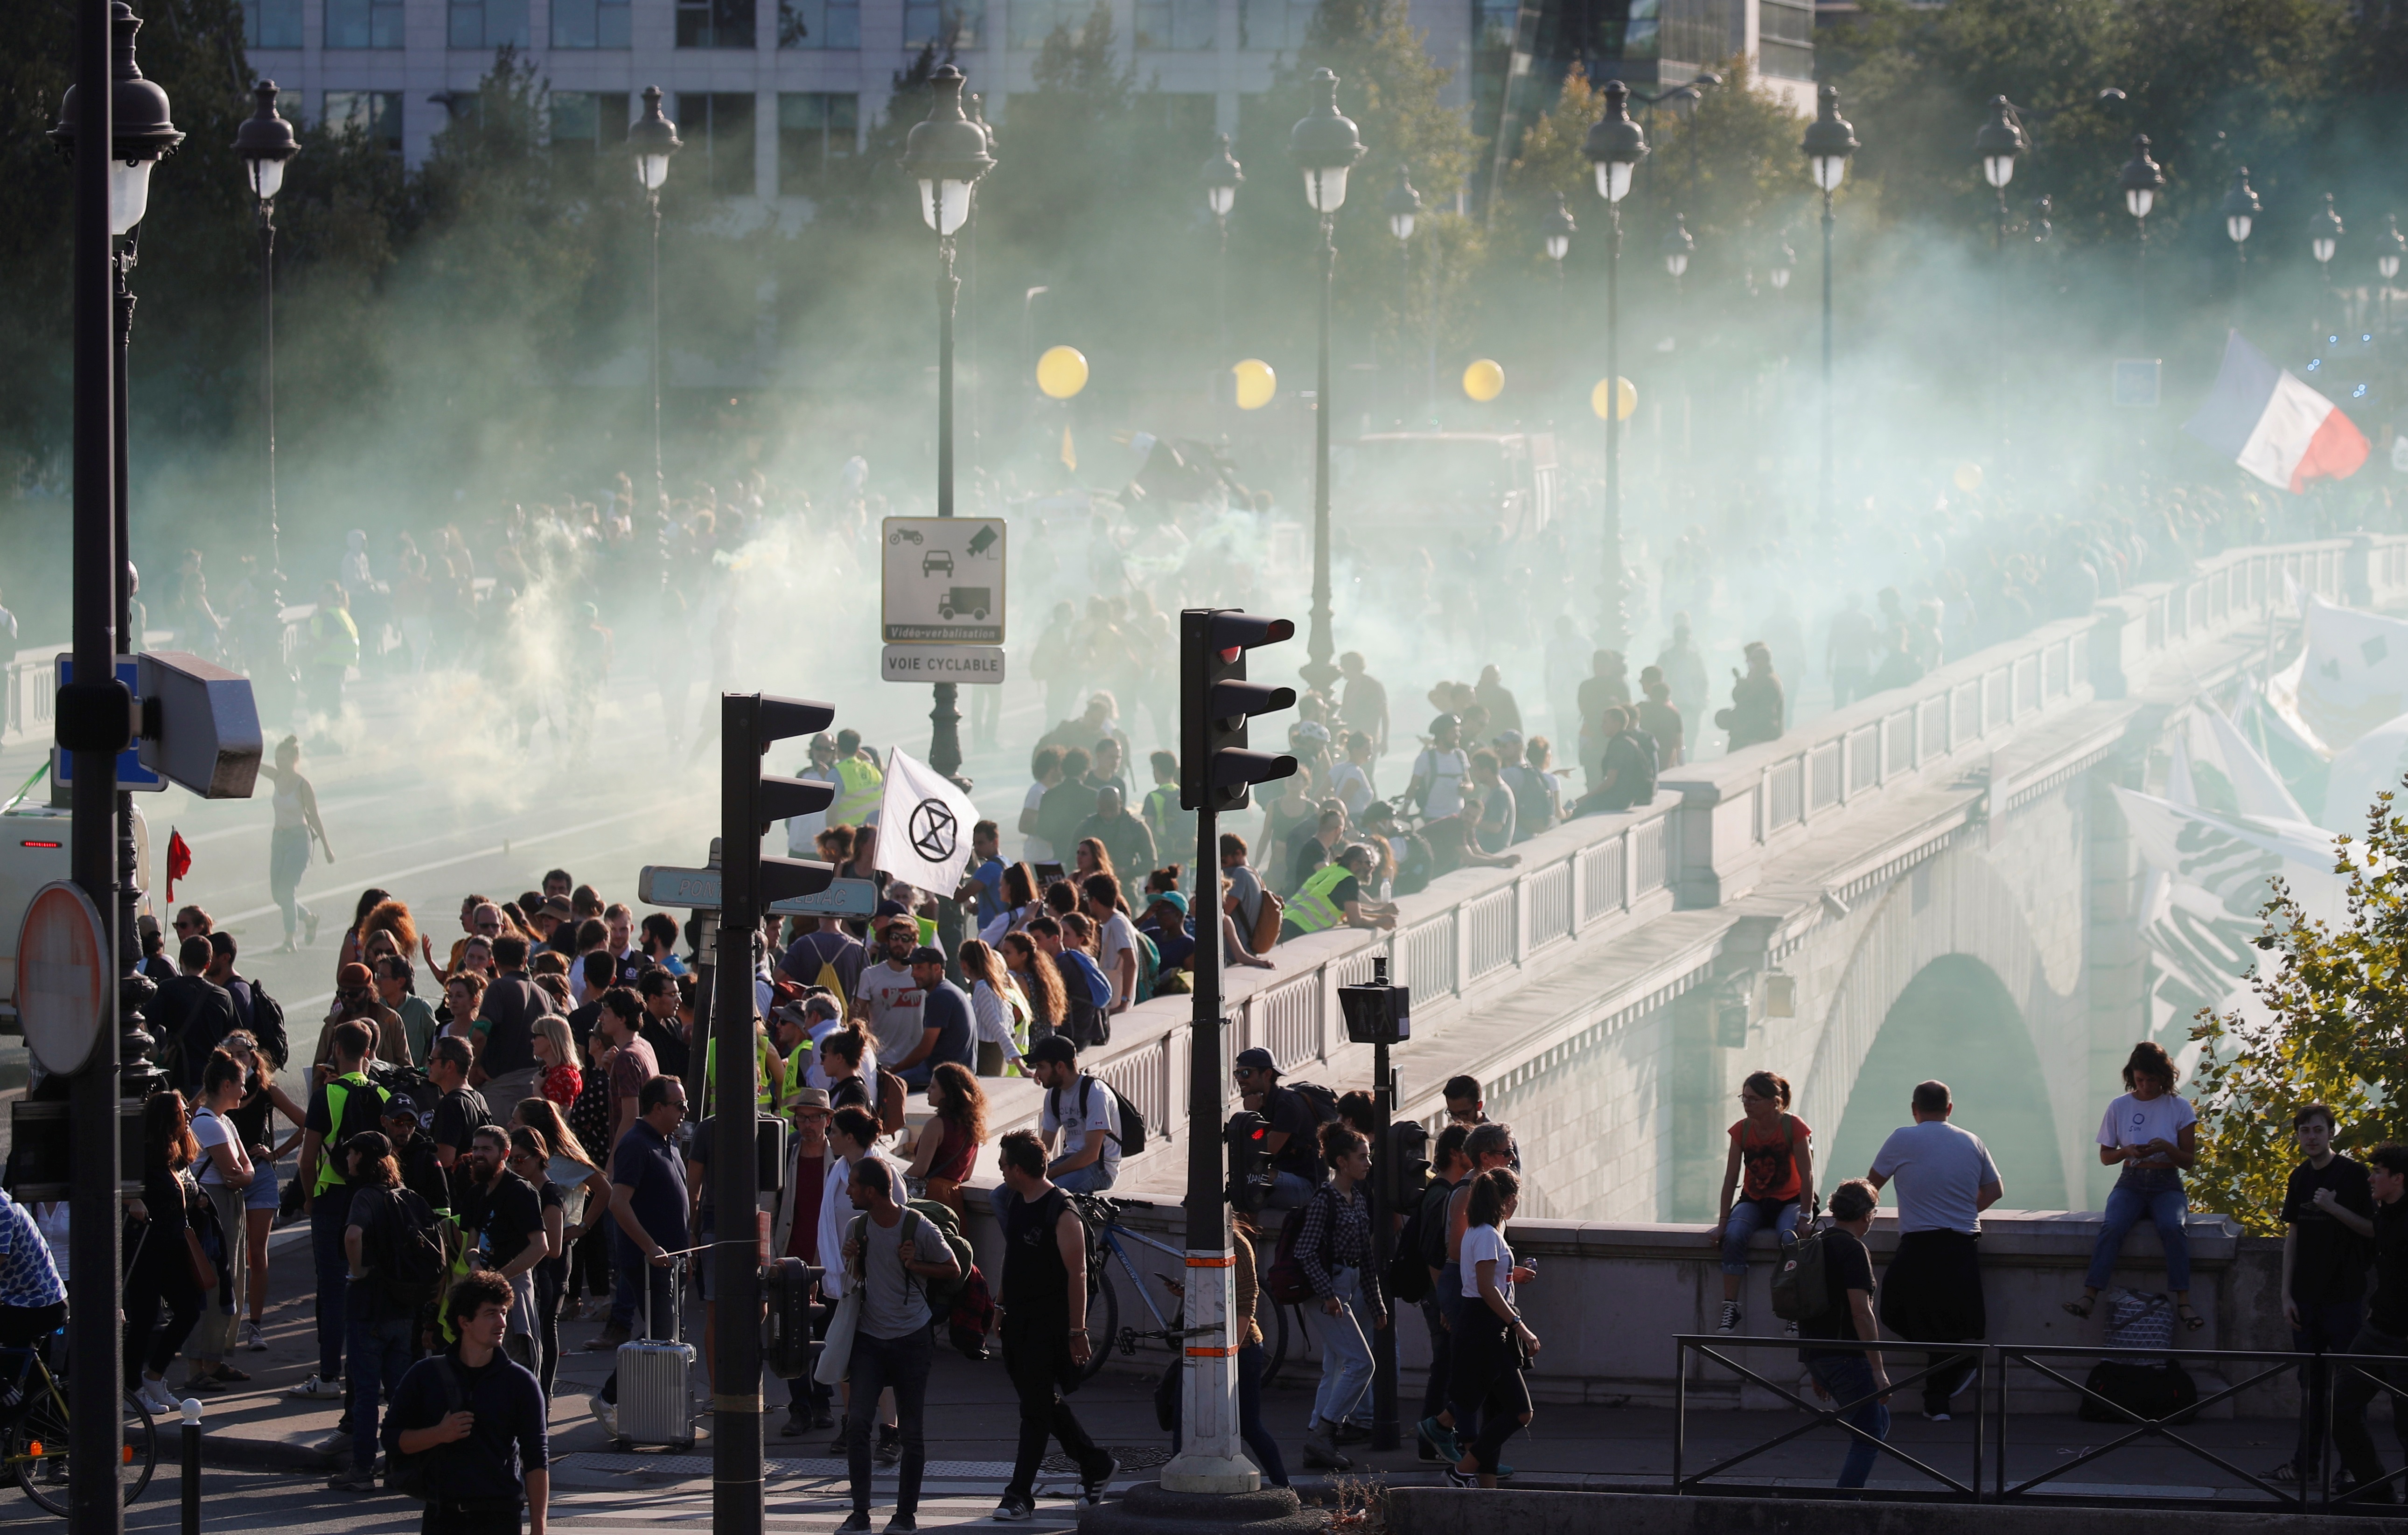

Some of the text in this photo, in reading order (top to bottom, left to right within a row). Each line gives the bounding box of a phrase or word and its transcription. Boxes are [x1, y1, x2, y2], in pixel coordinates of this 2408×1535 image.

[891, 627, 996, 639] Vidéo-verbalisation
[888, 657, 998, 671] VOIE CYCLABLE
[1246, 1172, 1269, 1184] XANE
[1117, 1251, 1140, 1284] DECATHLON
